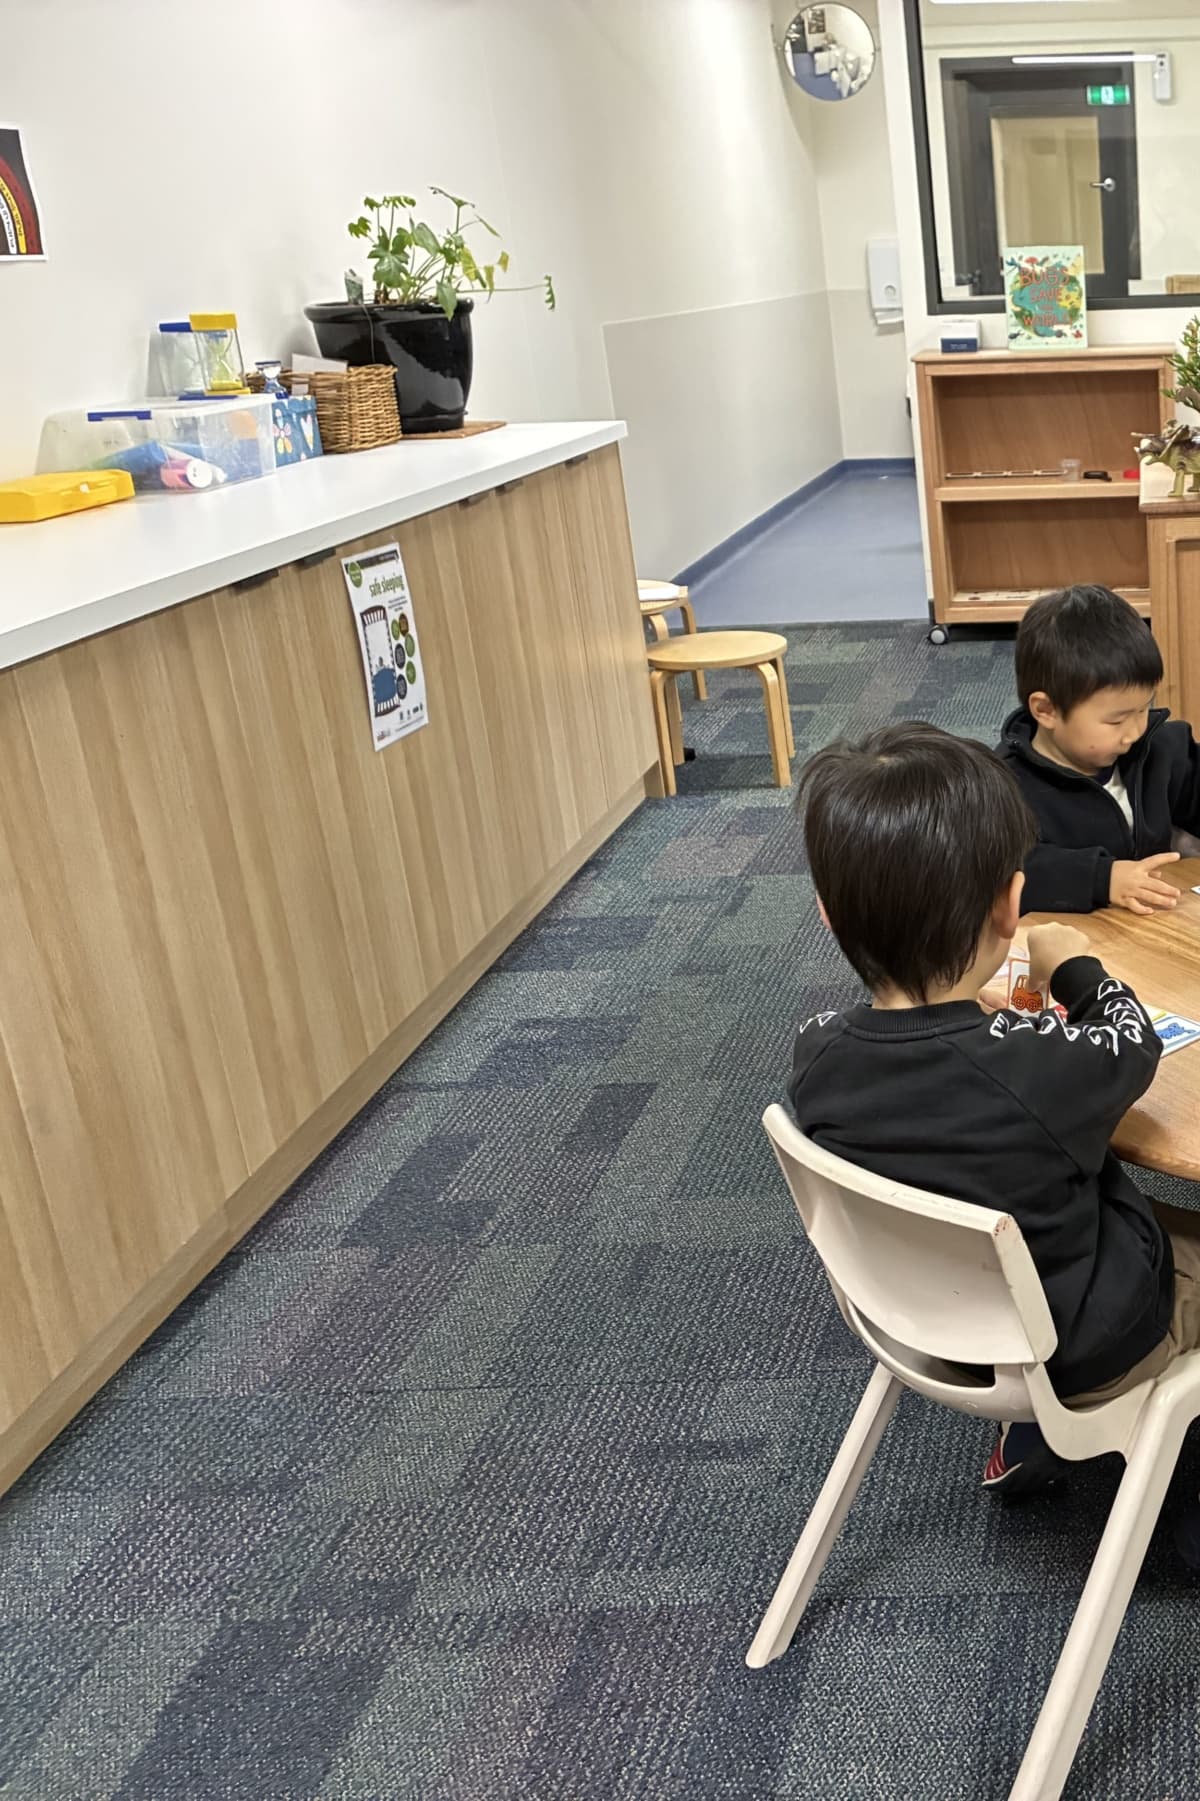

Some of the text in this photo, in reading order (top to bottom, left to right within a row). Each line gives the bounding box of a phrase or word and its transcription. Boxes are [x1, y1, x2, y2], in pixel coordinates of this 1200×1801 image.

[1020, 266, 1070, 286] BUGS
[1030, 288, 1062, 304] SAVE
[369, 578, 382, 598] safe
[381, 572, 404, 594] sleeping
